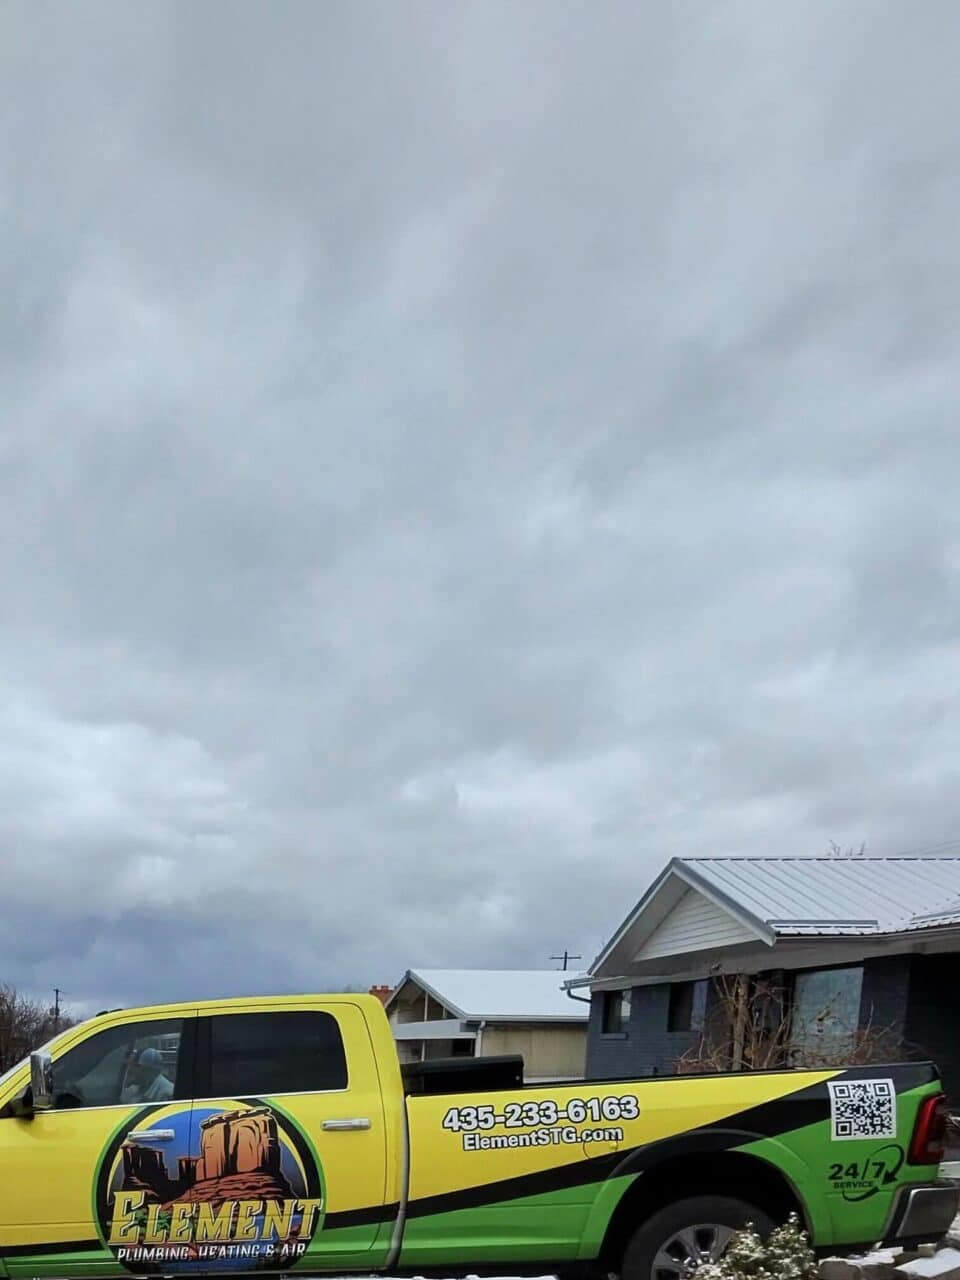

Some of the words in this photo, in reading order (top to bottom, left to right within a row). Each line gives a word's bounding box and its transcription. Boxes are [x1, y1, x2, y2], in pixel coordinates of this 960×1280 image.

[443, 1095, 639, 1131] 435-233-6163
[463, 1126, 623, 1151] ElementSTG.com
[828, 1159, 886, 1180] 24/7
[833, 1181, 873, 1189] SERVICE
[108, 1190, 321, 1245] ELEMENT
[199, 1244, 259, 1260] HEATING
[265, 1244, 274, 1257] &
[280, 1243, 306, 1258] AIR
